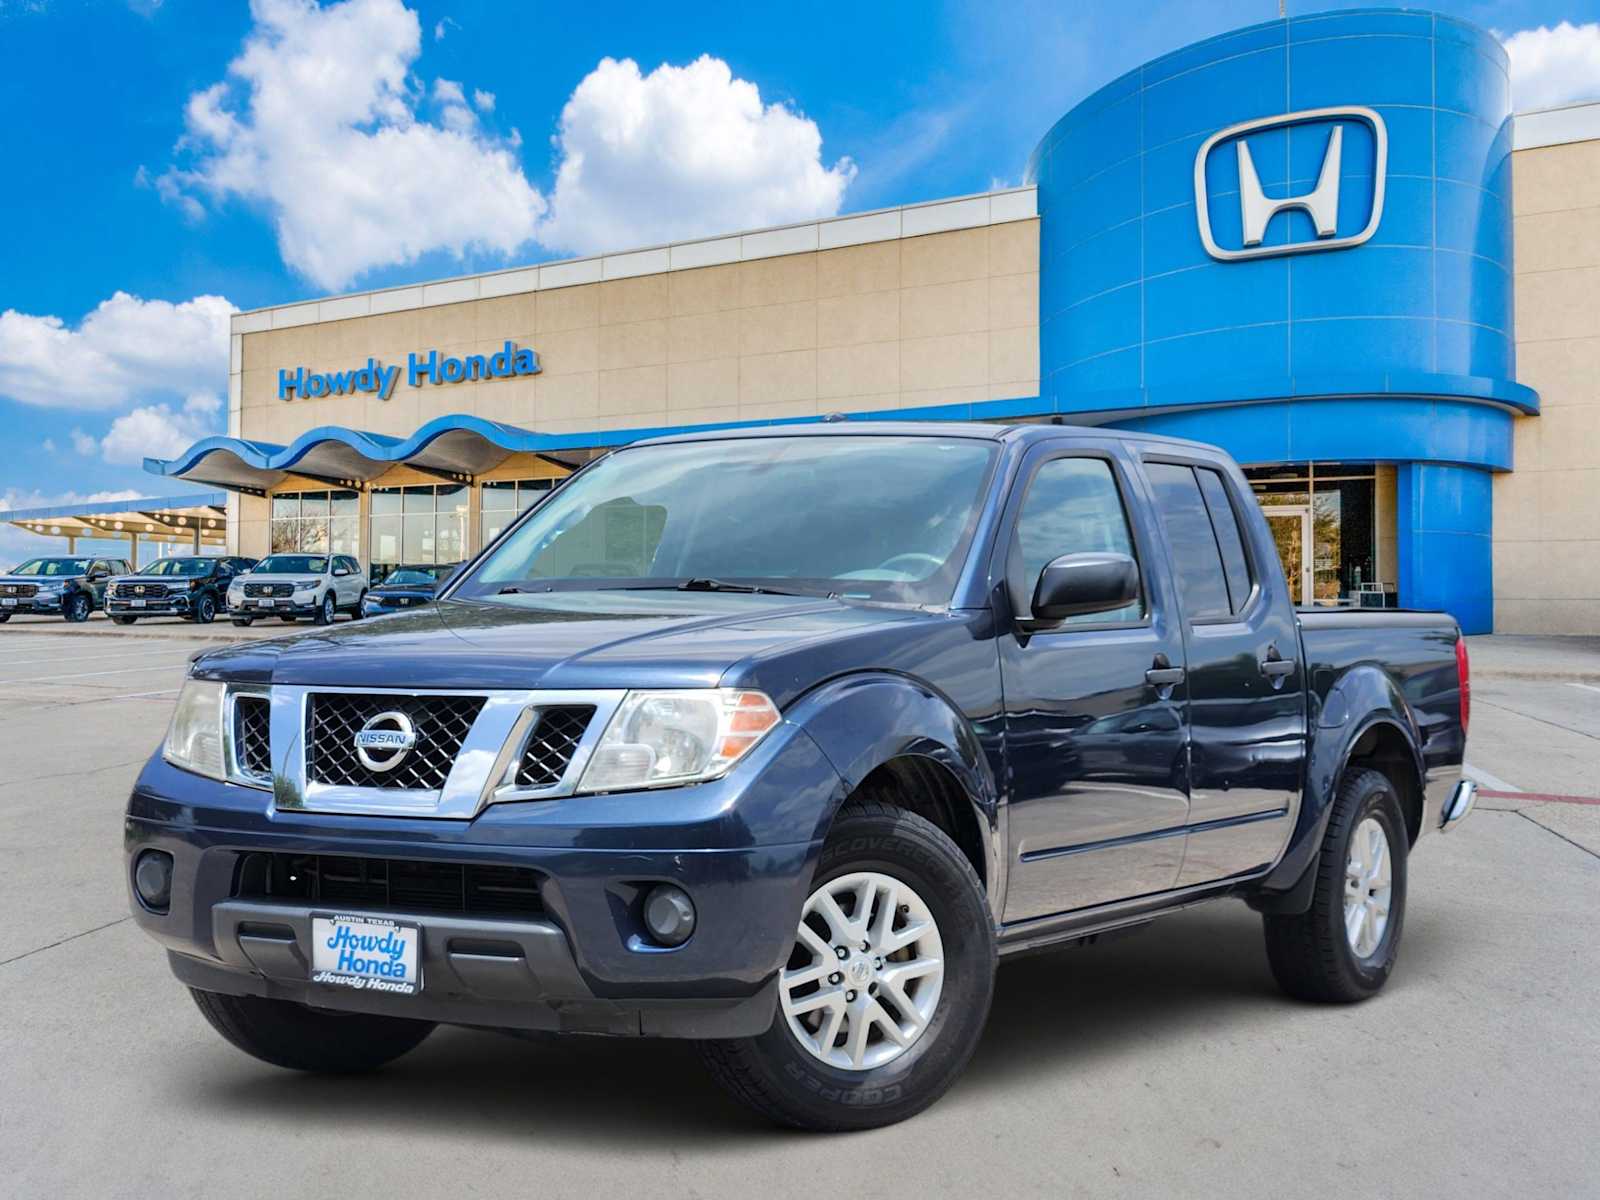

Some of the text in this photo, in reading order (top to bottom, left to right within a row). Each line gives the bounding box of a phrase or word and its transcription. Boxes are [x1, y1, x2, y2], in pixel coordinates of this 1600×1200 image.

[278, 340, 541, 401] Howdy Honda
[359, 733, 407, 745] NISSAN
[820, 836, 942, 874] SCOVERER
[334, 915, 395, 927] AUSTIN TEXAS
[327, 925, 406, 960] Howdy
[336, 949, 407, 978] Honda
[313, 971, 415, 994] Howdy Honda
